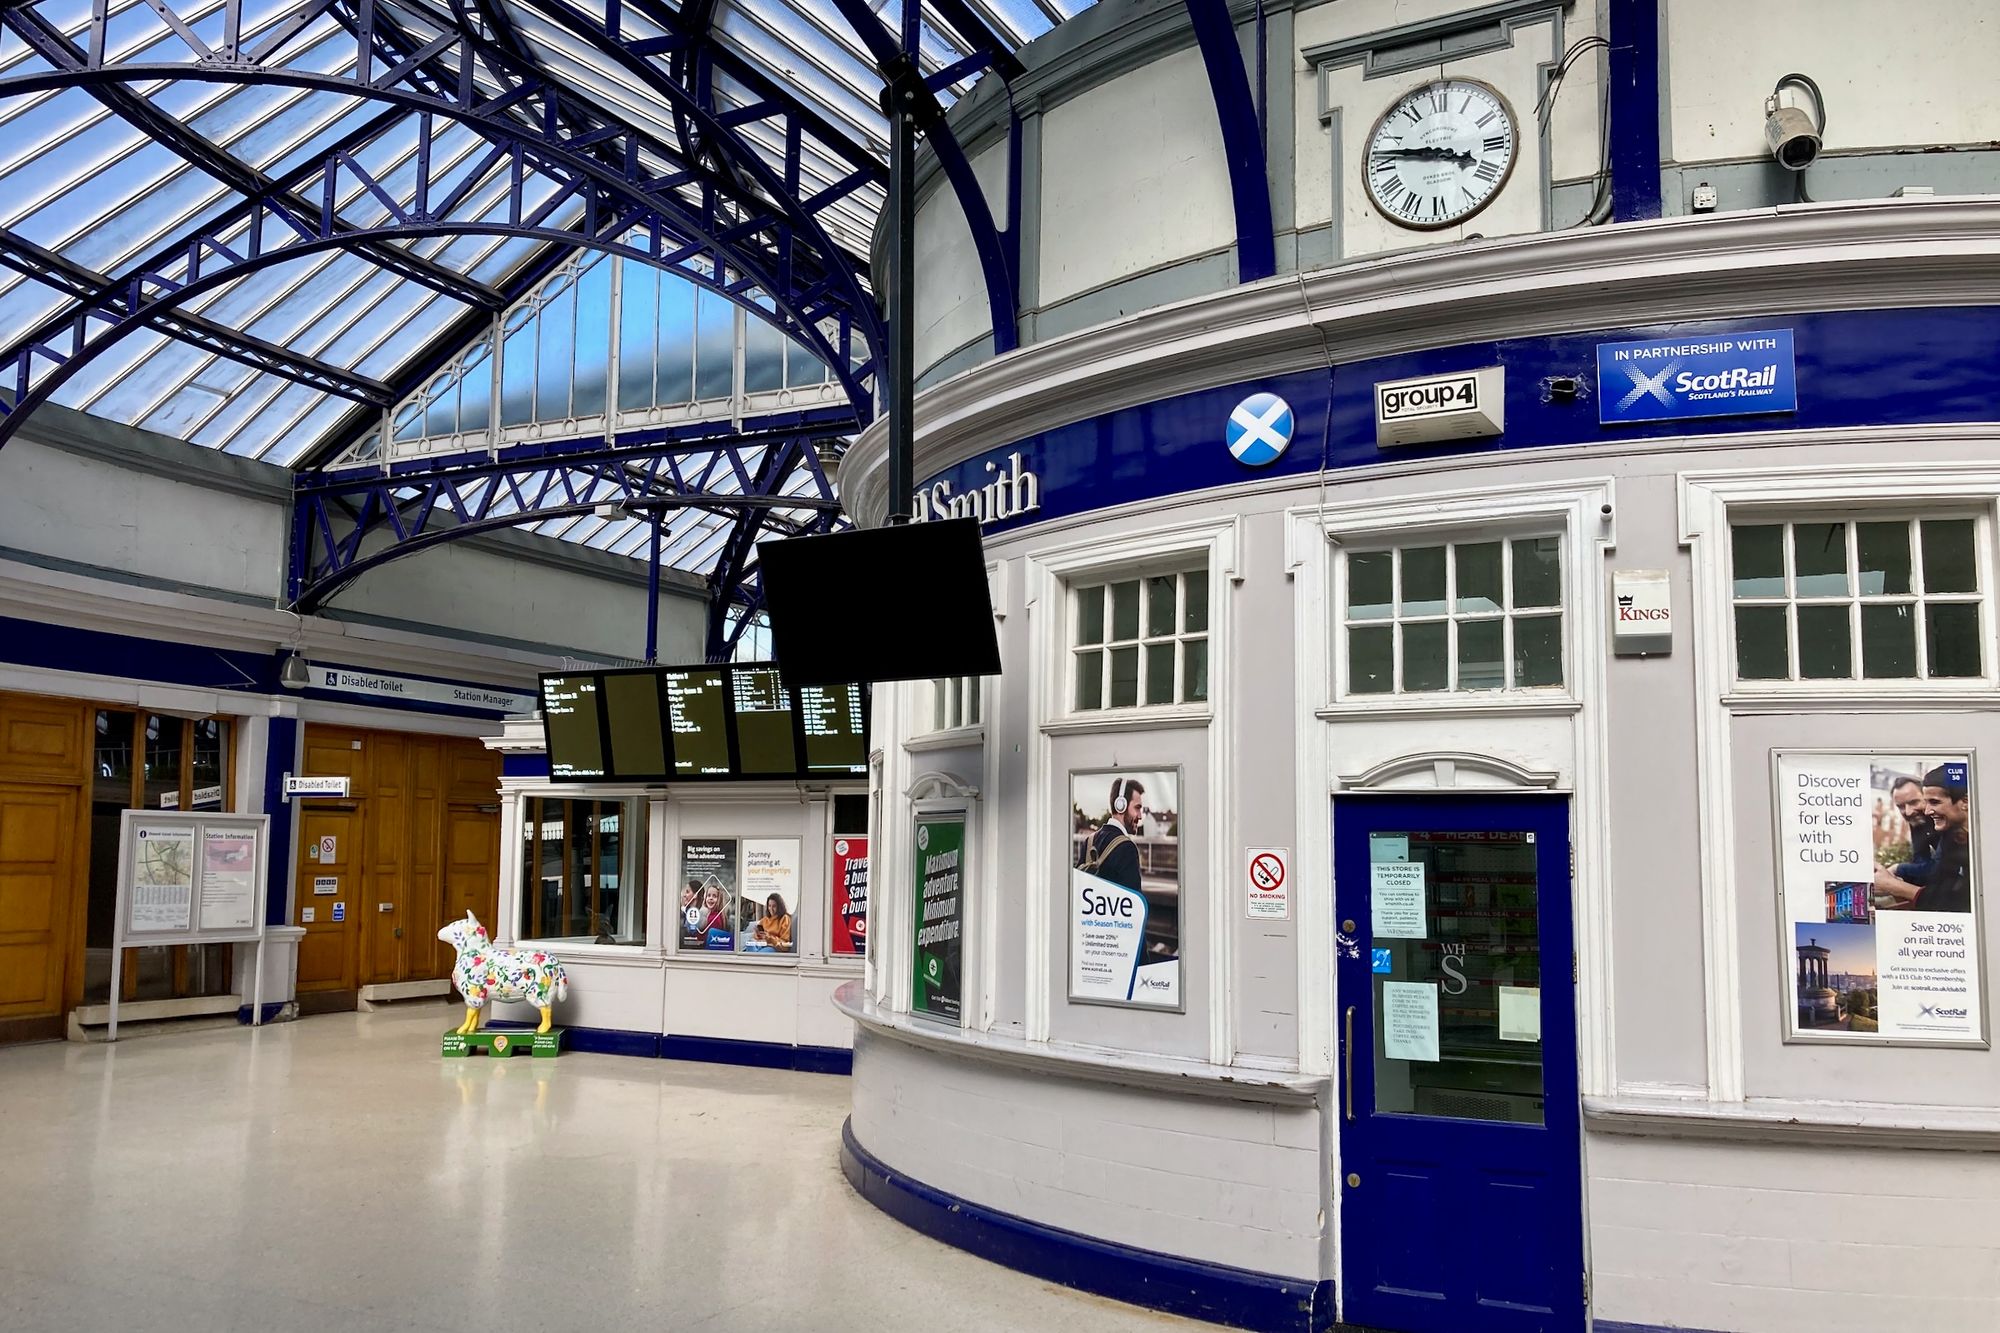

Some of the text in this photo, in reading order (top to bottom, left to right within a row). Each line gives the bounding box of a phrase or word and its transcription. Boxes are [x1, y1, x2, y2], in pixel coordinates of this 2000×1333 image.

[1428, 92, 1448, 115] XII
[1398, 104, 1423, 128] XI
[1474, 109, 1497, 129] II
[1483, 135, 1505, 152] III
[1615, 338, 1776, 360] IN PARTNERSHIP WITH
[1675, 364, 1777, 393] ScotRail
[1738, 388, 1774, 397] RAILWAY
[909, 451, 1040, 524] HSmith
[1619, 607, 1669, 620] KINGS
[341, 675, 403, 692] Disabled Toilet
[454, 690, 514, 707] Station Manager
[299, 780, 341, 789] Disabled Toilet
[1798, 774, 1861, 788] Discover
[1798, 792, 1862, 807] Scotland
[1798, 810, 1852, 825] for less
[1799, 830, 1832, 844] with
[748, 851, 771, 859] Journey
[1800, 848, 1859, 864] Club 50
[844, 857, 868, 871] Trave
[761, 867, 791, 876] fingertips
[844, 874, 850, 886] a
[842, 903, 848, 915] a
[1082, 888, 1132, 917] Save
[1911, 923, 1934, 932] Save
[1919, 936, 1934, 945] rail
[1937, 937, 1964, 946] travel
[1441, 944, 1466, 955] WH
[1898, 948, 1965, 959] all year round
[1441, 955, 1467, 994] S
[1150, 980, 1170, 988] ScotRail
[1935, 1008, 1967, 1016] ScotRail
